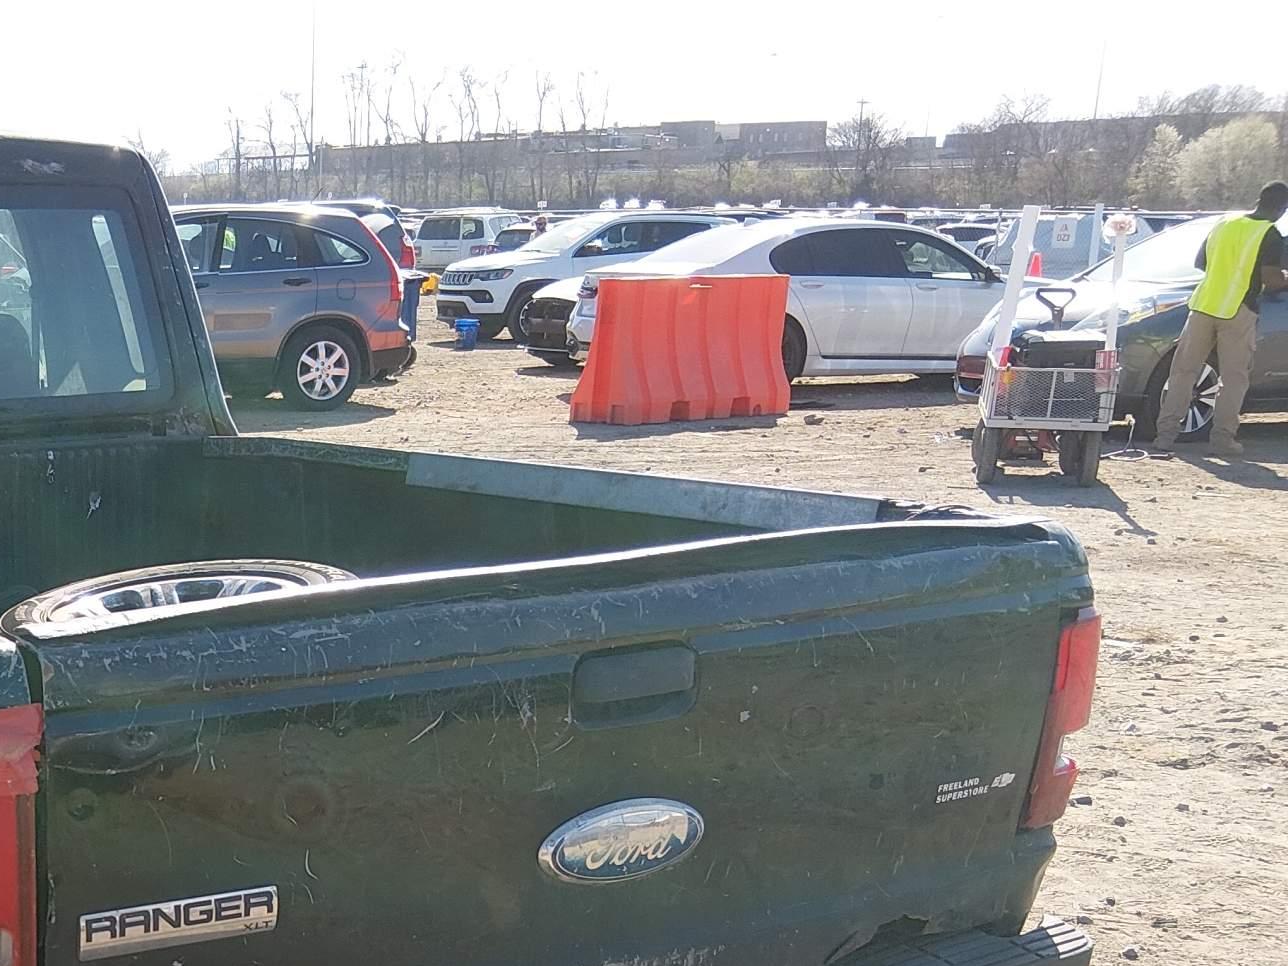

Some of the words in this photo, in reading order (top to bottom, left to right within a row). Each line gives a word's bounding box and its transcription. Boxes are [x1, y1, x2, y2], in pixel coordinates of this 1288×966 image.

[935, 785, 989, 804] SUPERSTORE
[937, 777, 980, 793] FREELAND
[585, 827, 673, 871] Ford
[85, 890, 274, 943] RANGER
[242, 919, 273, 932] XLT
